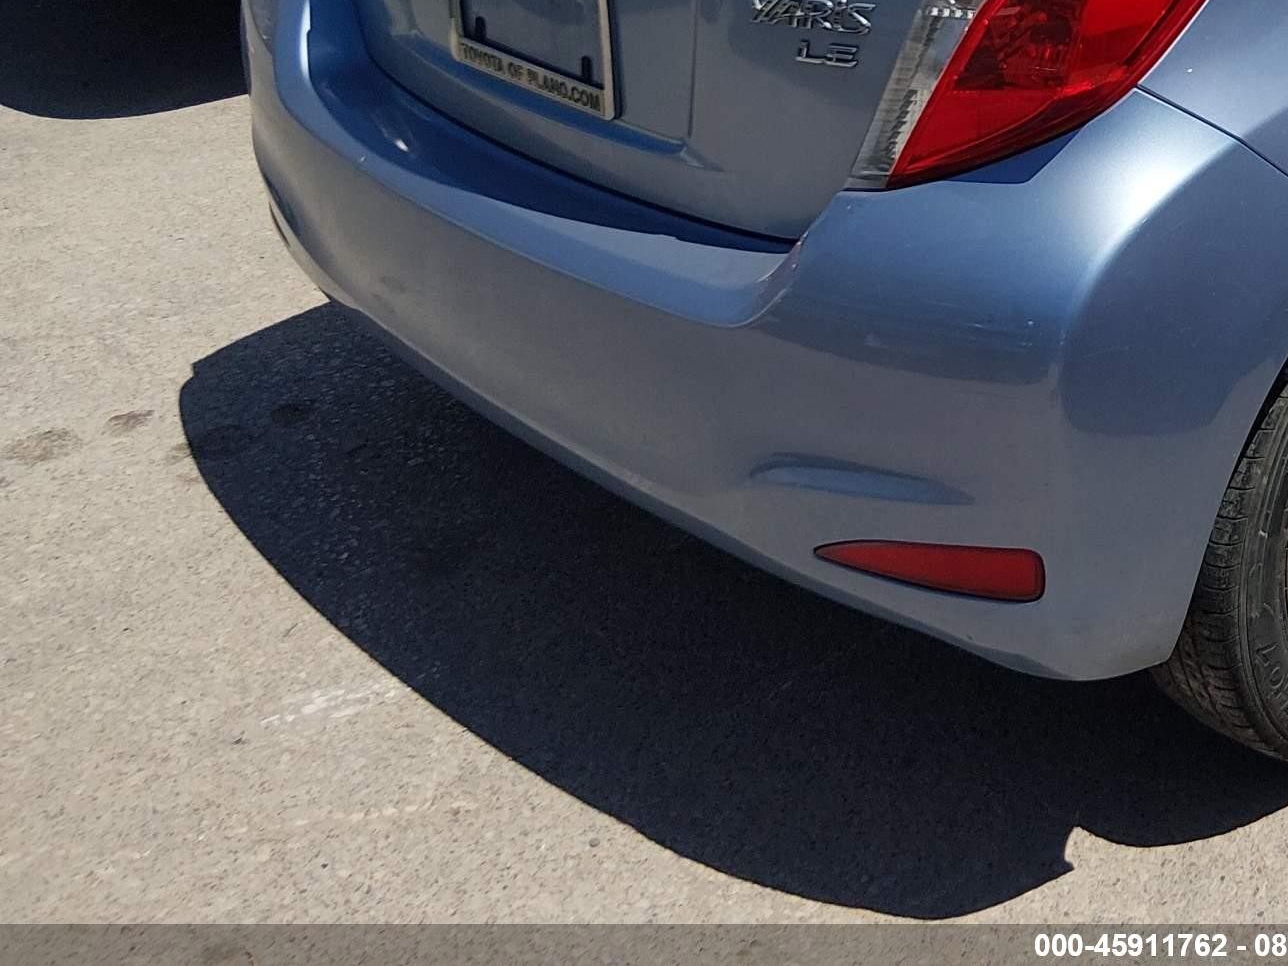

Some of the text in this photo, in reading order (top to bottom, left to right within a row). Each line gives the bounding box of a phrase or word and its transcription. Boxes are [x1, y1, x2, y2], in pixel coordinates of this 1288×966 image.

[460, 42, 601, 112] TOYOTA OF PLANO.COM
[795, 40, 858, 68] LE
